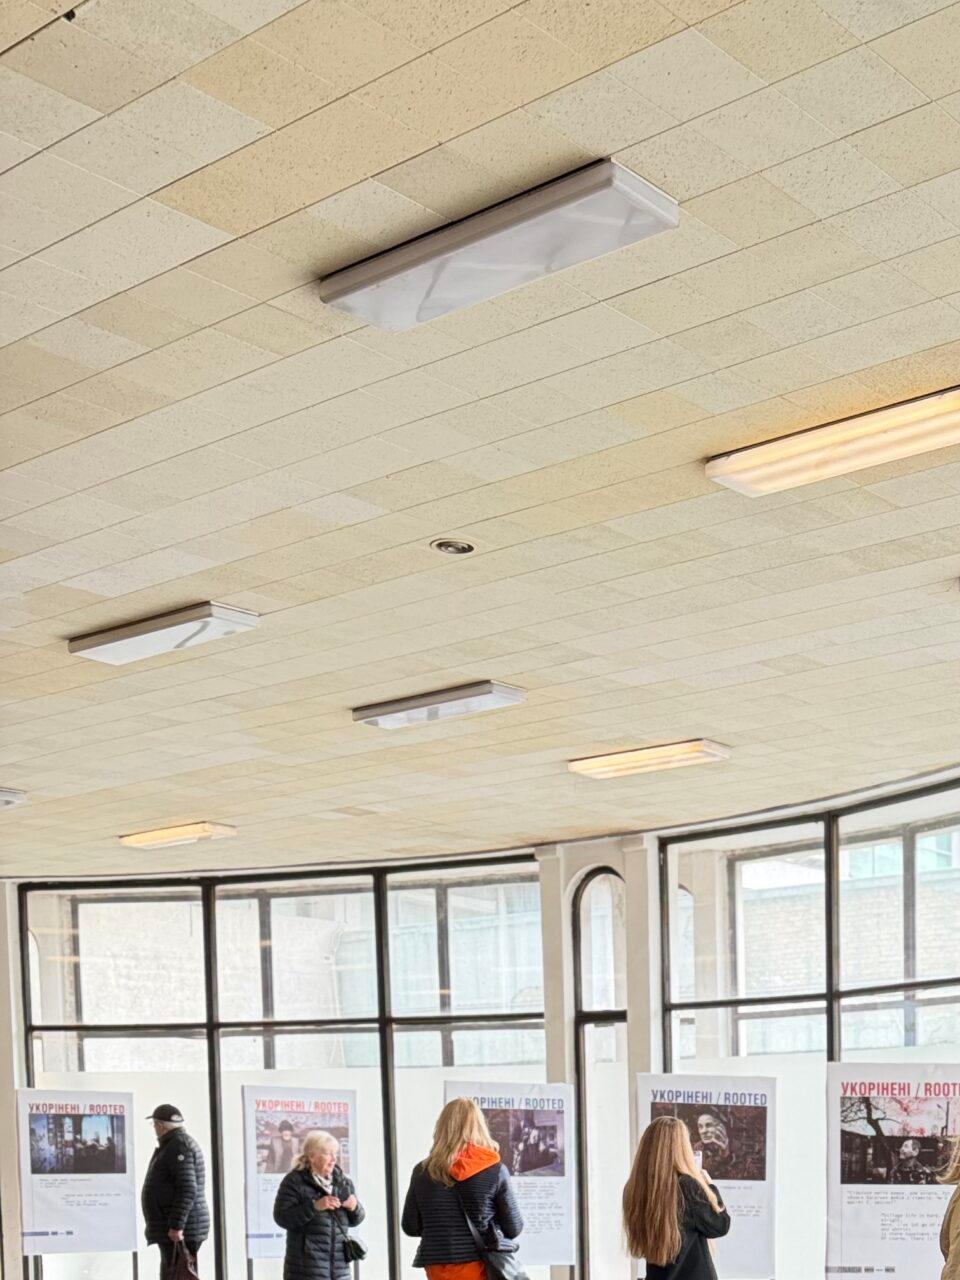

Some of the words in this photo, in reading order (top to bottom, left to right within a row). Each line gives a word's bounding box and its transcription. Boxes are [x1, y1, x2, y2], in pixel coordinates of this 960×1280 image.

[841, 1082, 911, 1096] УКОРІНЕНІ
[651, 1089, 712, 1104] УКОРІНЕНІ
[724, 1092, 767, 1105] ROOTED
[89, 1104, 125, 1114] ROOTED
[314, 1101, 349, 1112] ROOTED
[525, 1098, 564, 1109] ROOTED
